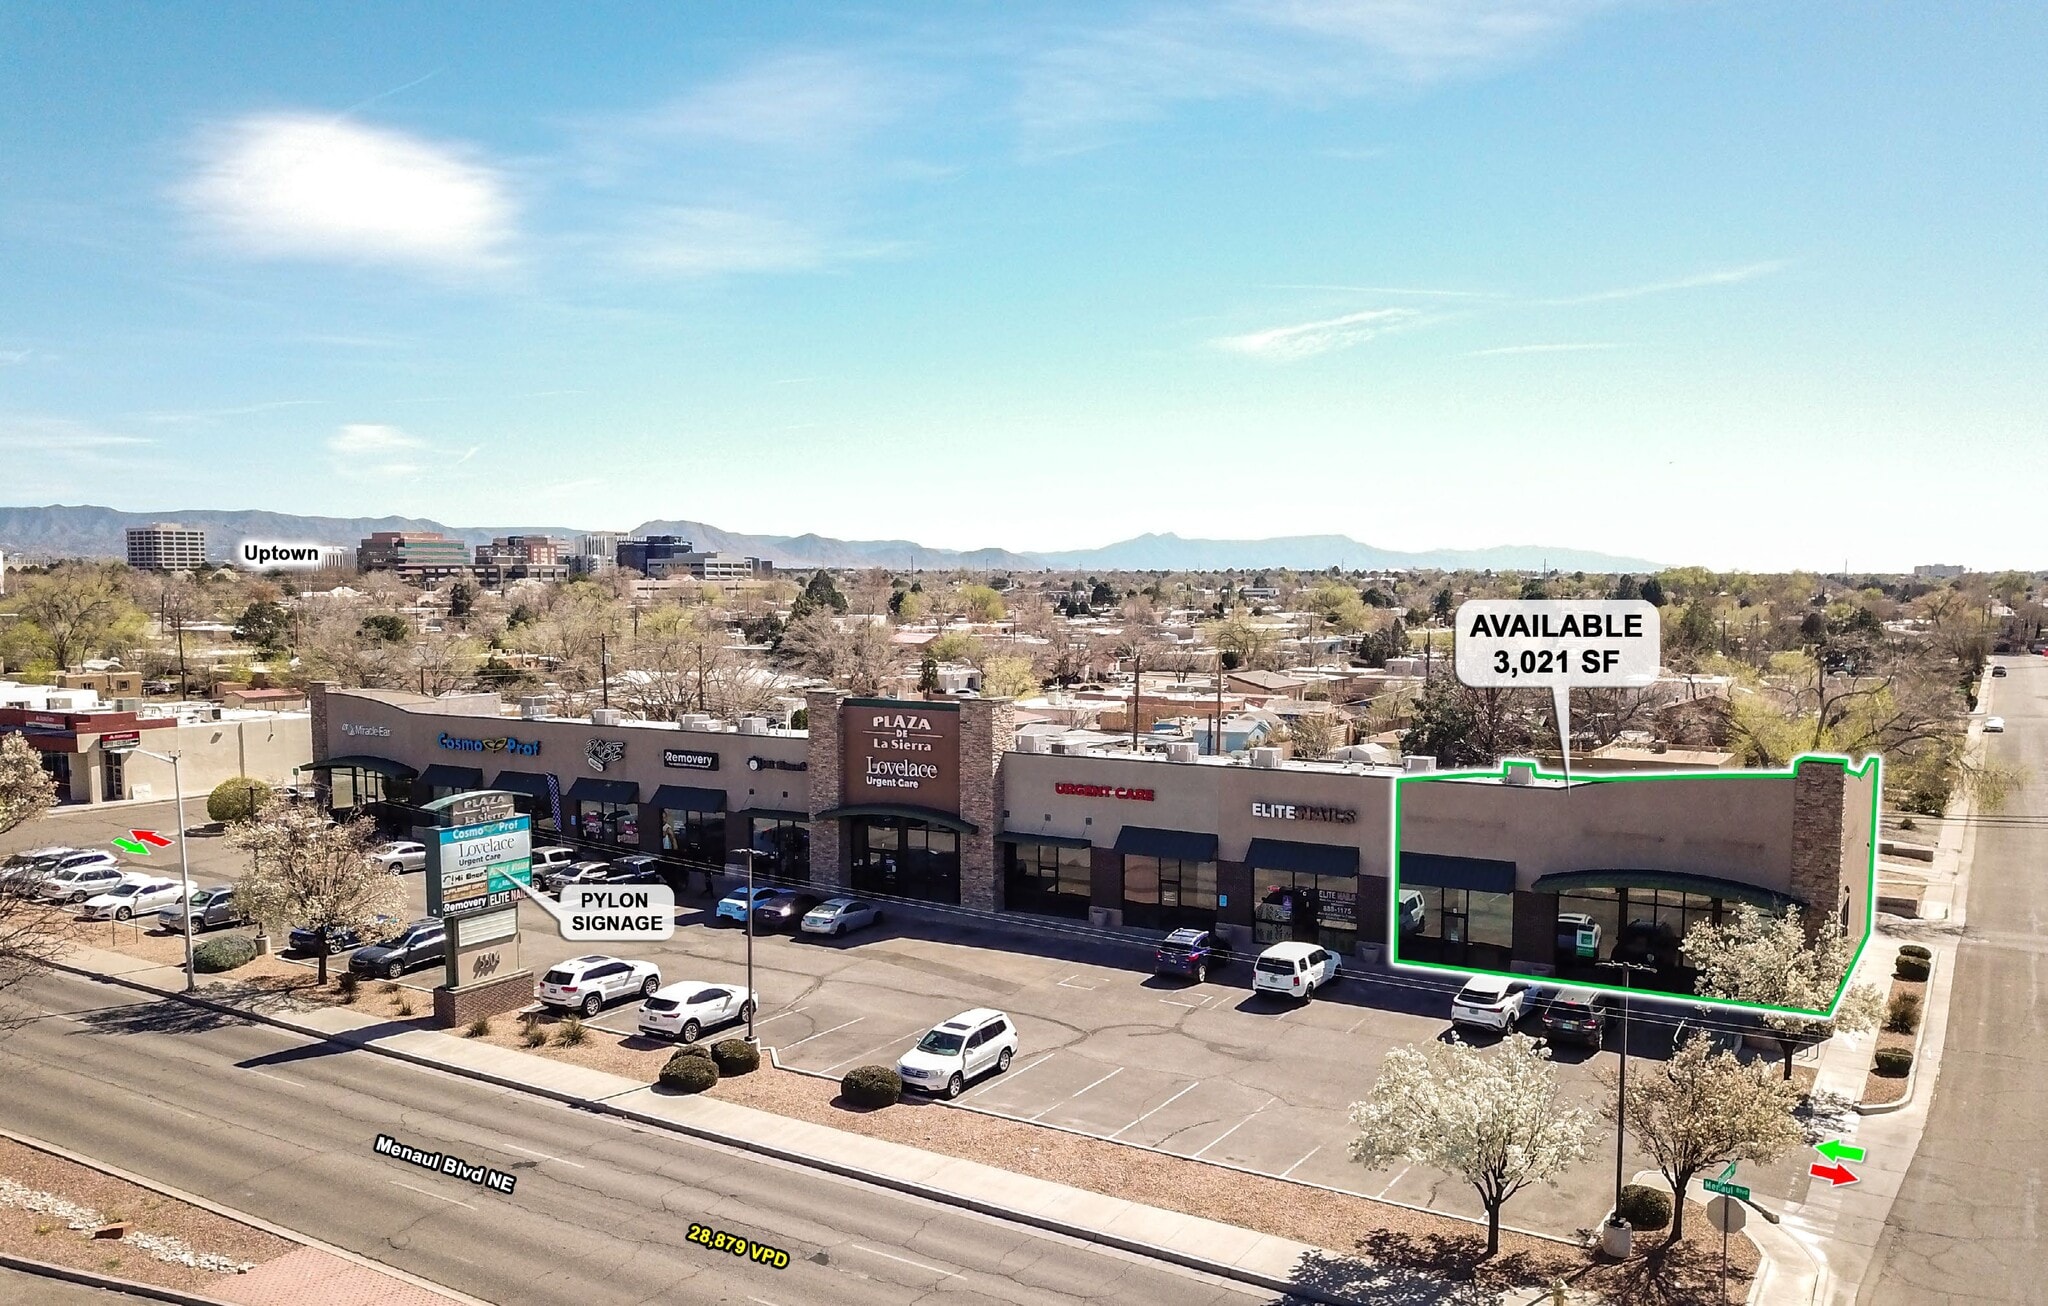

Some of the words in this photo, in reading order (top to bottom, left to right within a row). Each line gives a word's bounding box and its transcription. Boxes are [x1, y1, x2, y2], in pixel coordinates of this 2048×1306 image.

[872, 714, 932, 730] PLAZA
[896, 729, 908, 738] DE
[438, 731, 483, 752] Cosmo
[507, 737, 541, 757] Prof
[873, 738, 889, 749] La
[891, 739, 932, 751] Sierra
[665, 751, 713, 767] Removery
[866, 756, 938, 779] Lovelace
[866, 776, 897, 788] Urgent
[898, 779, 919, 789] Care
[1055, 782, 1112, 798] URGENT
[1114, 787, 1155, 802] CARE
[464, 795, 504, 809] PLAZA
[1252, 802, 1296, 820] ELITE
[1297, 805, 1357, 825] NAILS
[453, 827, 484, 840] Cosmo
[499, 820, 518, 832] Prof
[459, 837, 515, 858] Lovelace
[458, 856, 484, 867] Urgent
[485, 853, 501, 862] Care
[443, 897, 487, 912] Removery
[490, 893, 510, 906] ELITE
